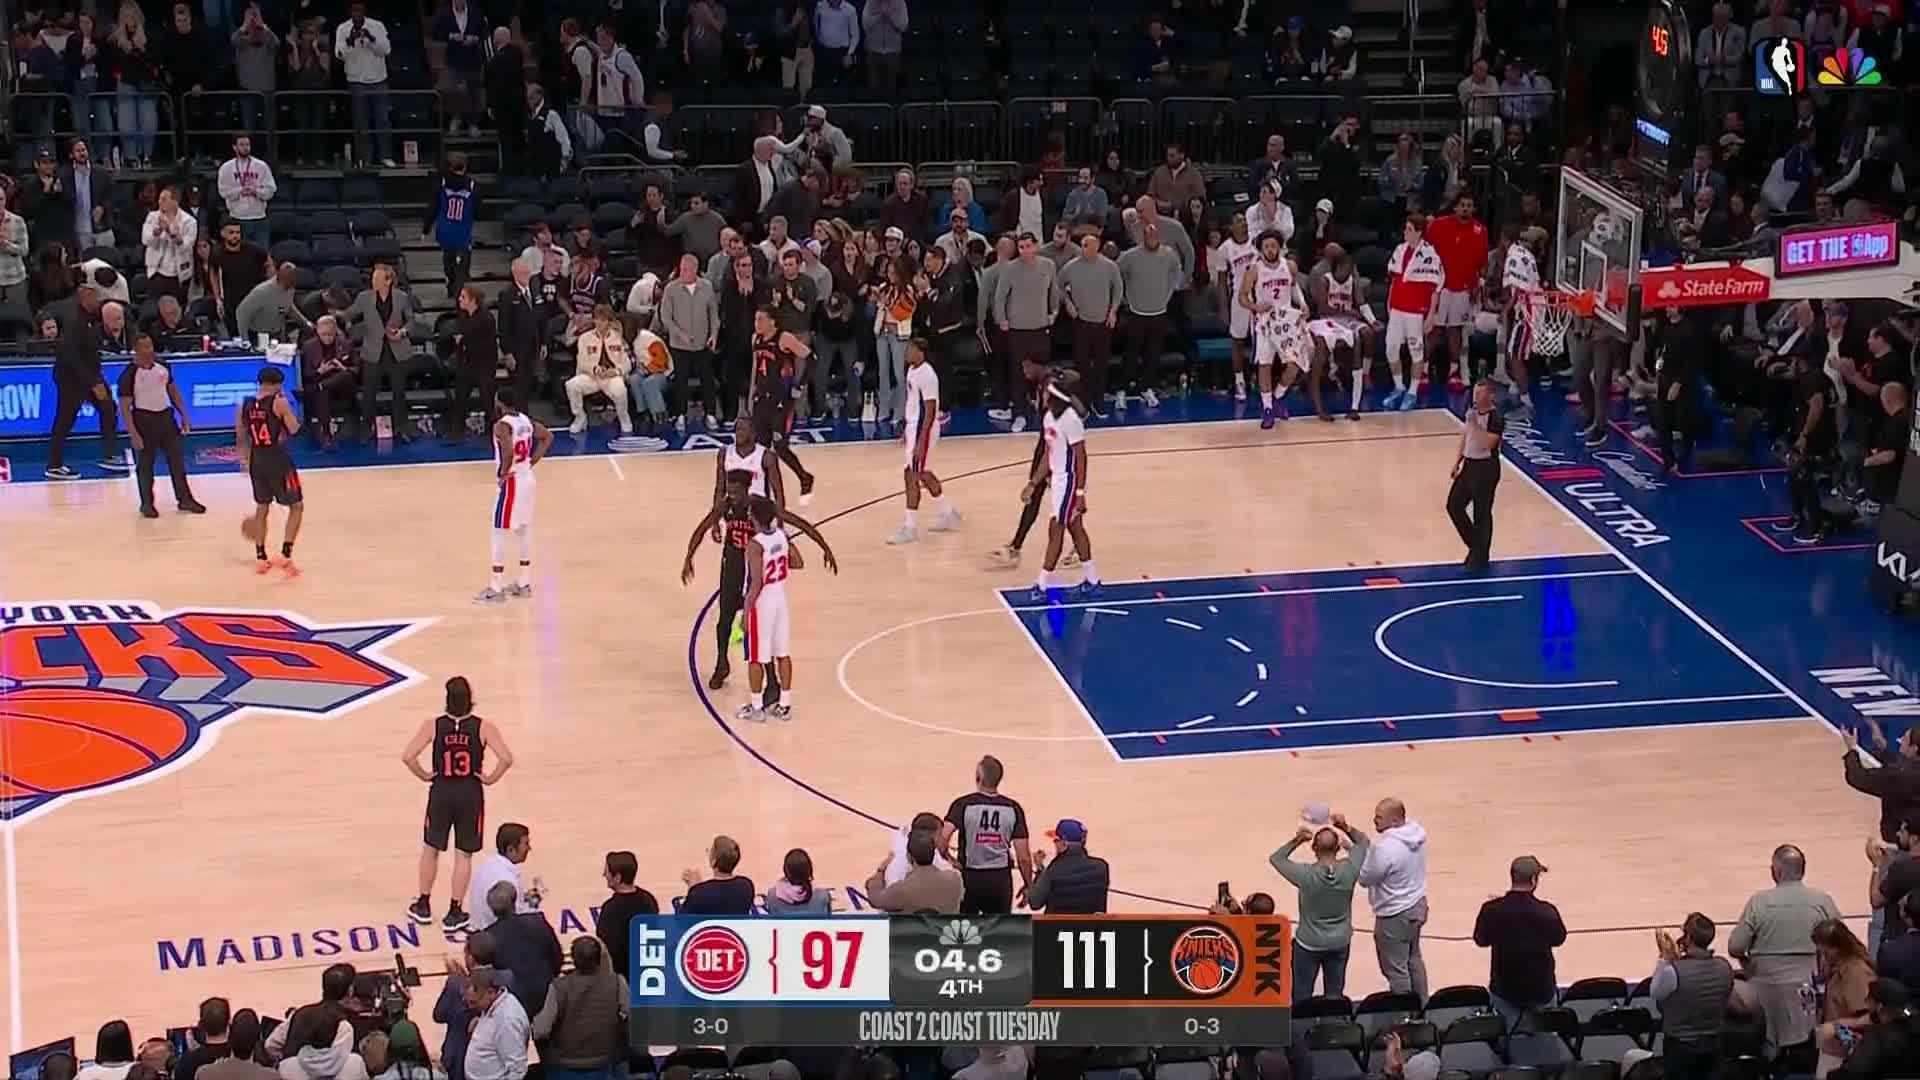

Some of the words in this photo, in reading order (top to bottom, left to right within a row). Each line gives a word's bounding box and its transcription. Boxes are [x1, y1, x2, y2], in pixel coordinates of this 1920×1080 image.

[1787, 238, 1815, 264] GET
[1819, 235, 1849, 261] THE
[1273, 288, 1281, 300] 2
[0, 383, 41, 421] OW
[192, 382, 259, 407] ESP
[250, 422, 272, 446] 14
[1564, 482, 1671, 549] ULTRA
[731, 530, 749, 548] 51
[765, 554, 788, 585] 23
[0, 604, 152, 624] YORK
[443, 750, 471, 777] 13
[980, 810, 1001, 832] 44
[157, 925, 421, 971] MADISON
